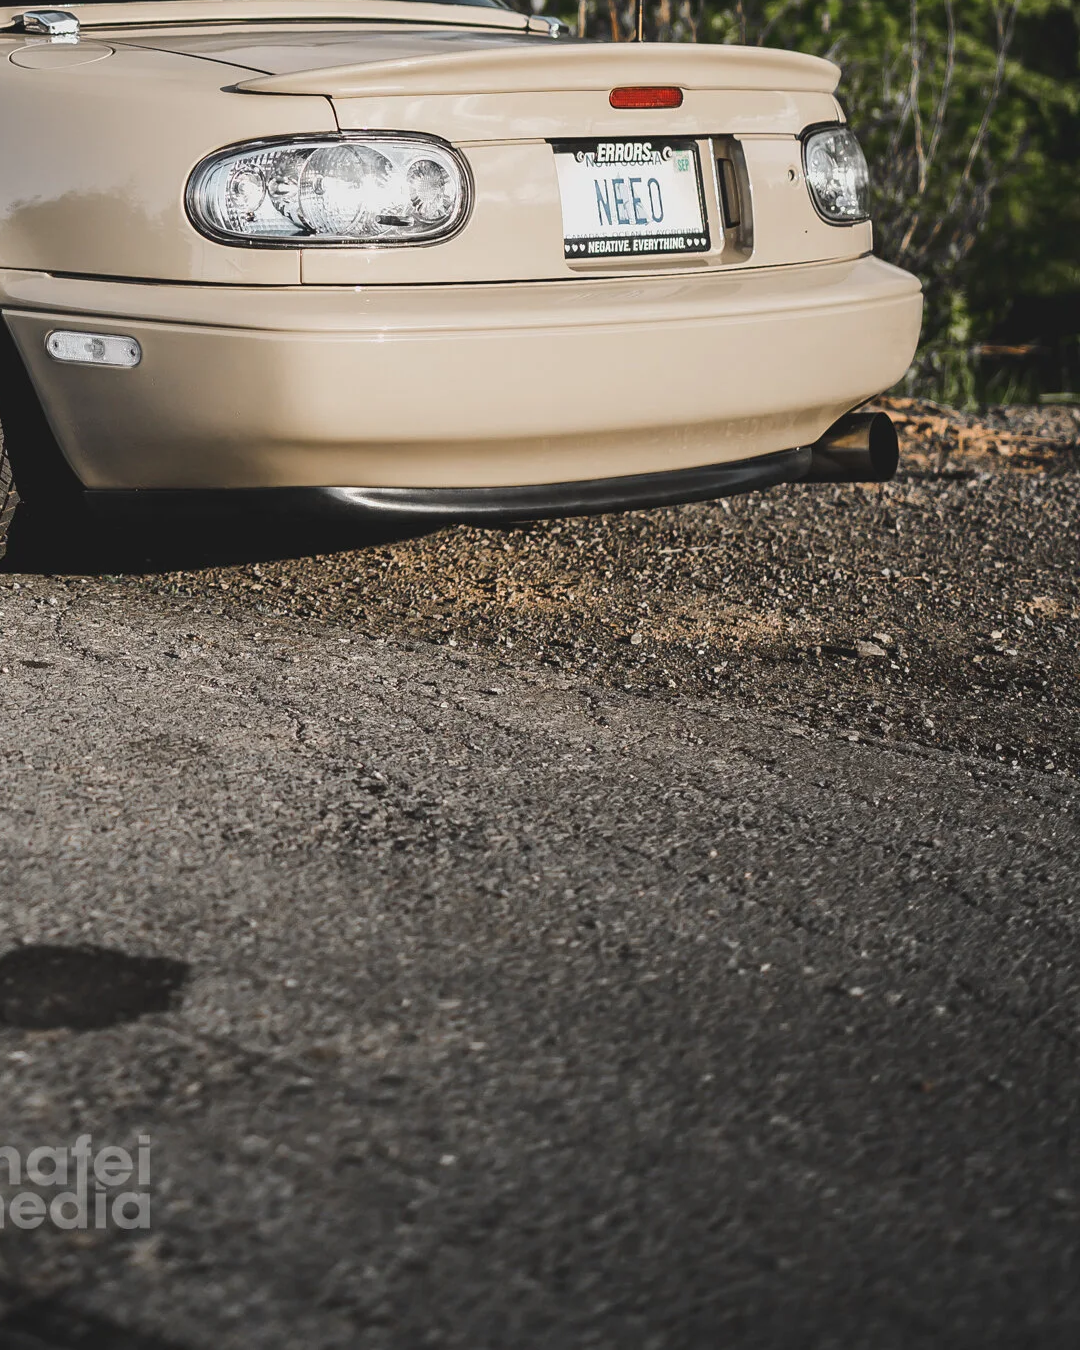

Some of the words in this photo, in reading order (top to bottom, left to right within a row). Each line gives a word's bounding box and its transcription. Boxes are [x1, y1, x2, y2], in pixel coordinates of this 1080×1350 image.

[677, 159, 690, 171] SEP
[594, 176, 664, 226] NEEO
[587, 240, 631, 253] NEGATIVE.
[633, 237, 685, 252] EVERYTHING.
